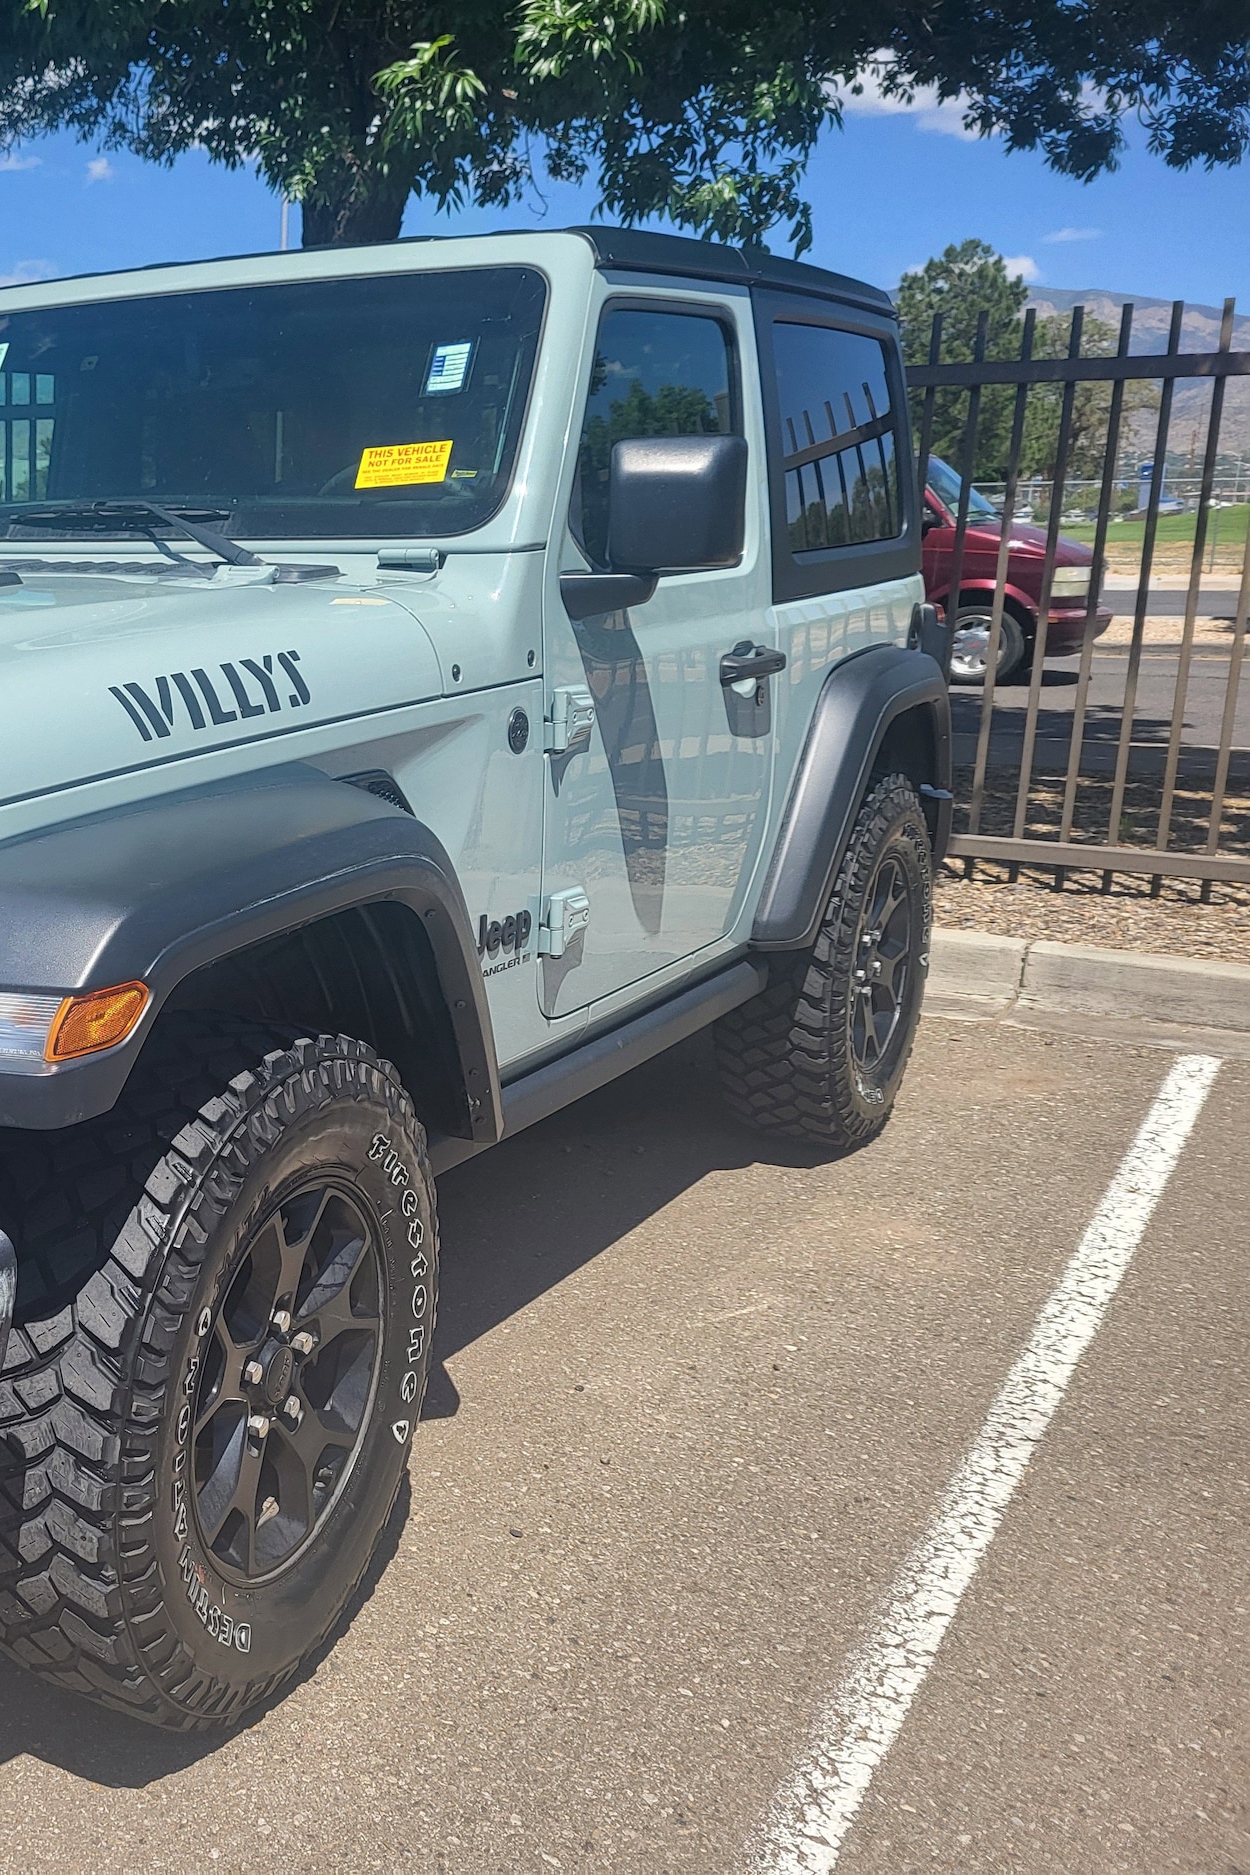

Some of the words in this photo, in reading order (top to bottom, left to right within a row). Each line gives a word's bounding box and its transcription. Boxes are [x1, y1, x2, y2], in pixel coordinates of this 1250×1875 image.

[368, 449, 394, 459] THIS
[397, 443, 447, 457] VEHICLE
[368, 459, 389, 468] NOT
[391, 457, 412, 466] FOR
[415, 455, 443, 464] SALE
[108, 649, 312, 742] WILLYS
[477, 909, 532, 956] Jeep
[482, 957, 520, 977] ANGLER
[367, 1132, 429, 1404] Firestone
[171, 1356, 252, 1653] DESTINATION
